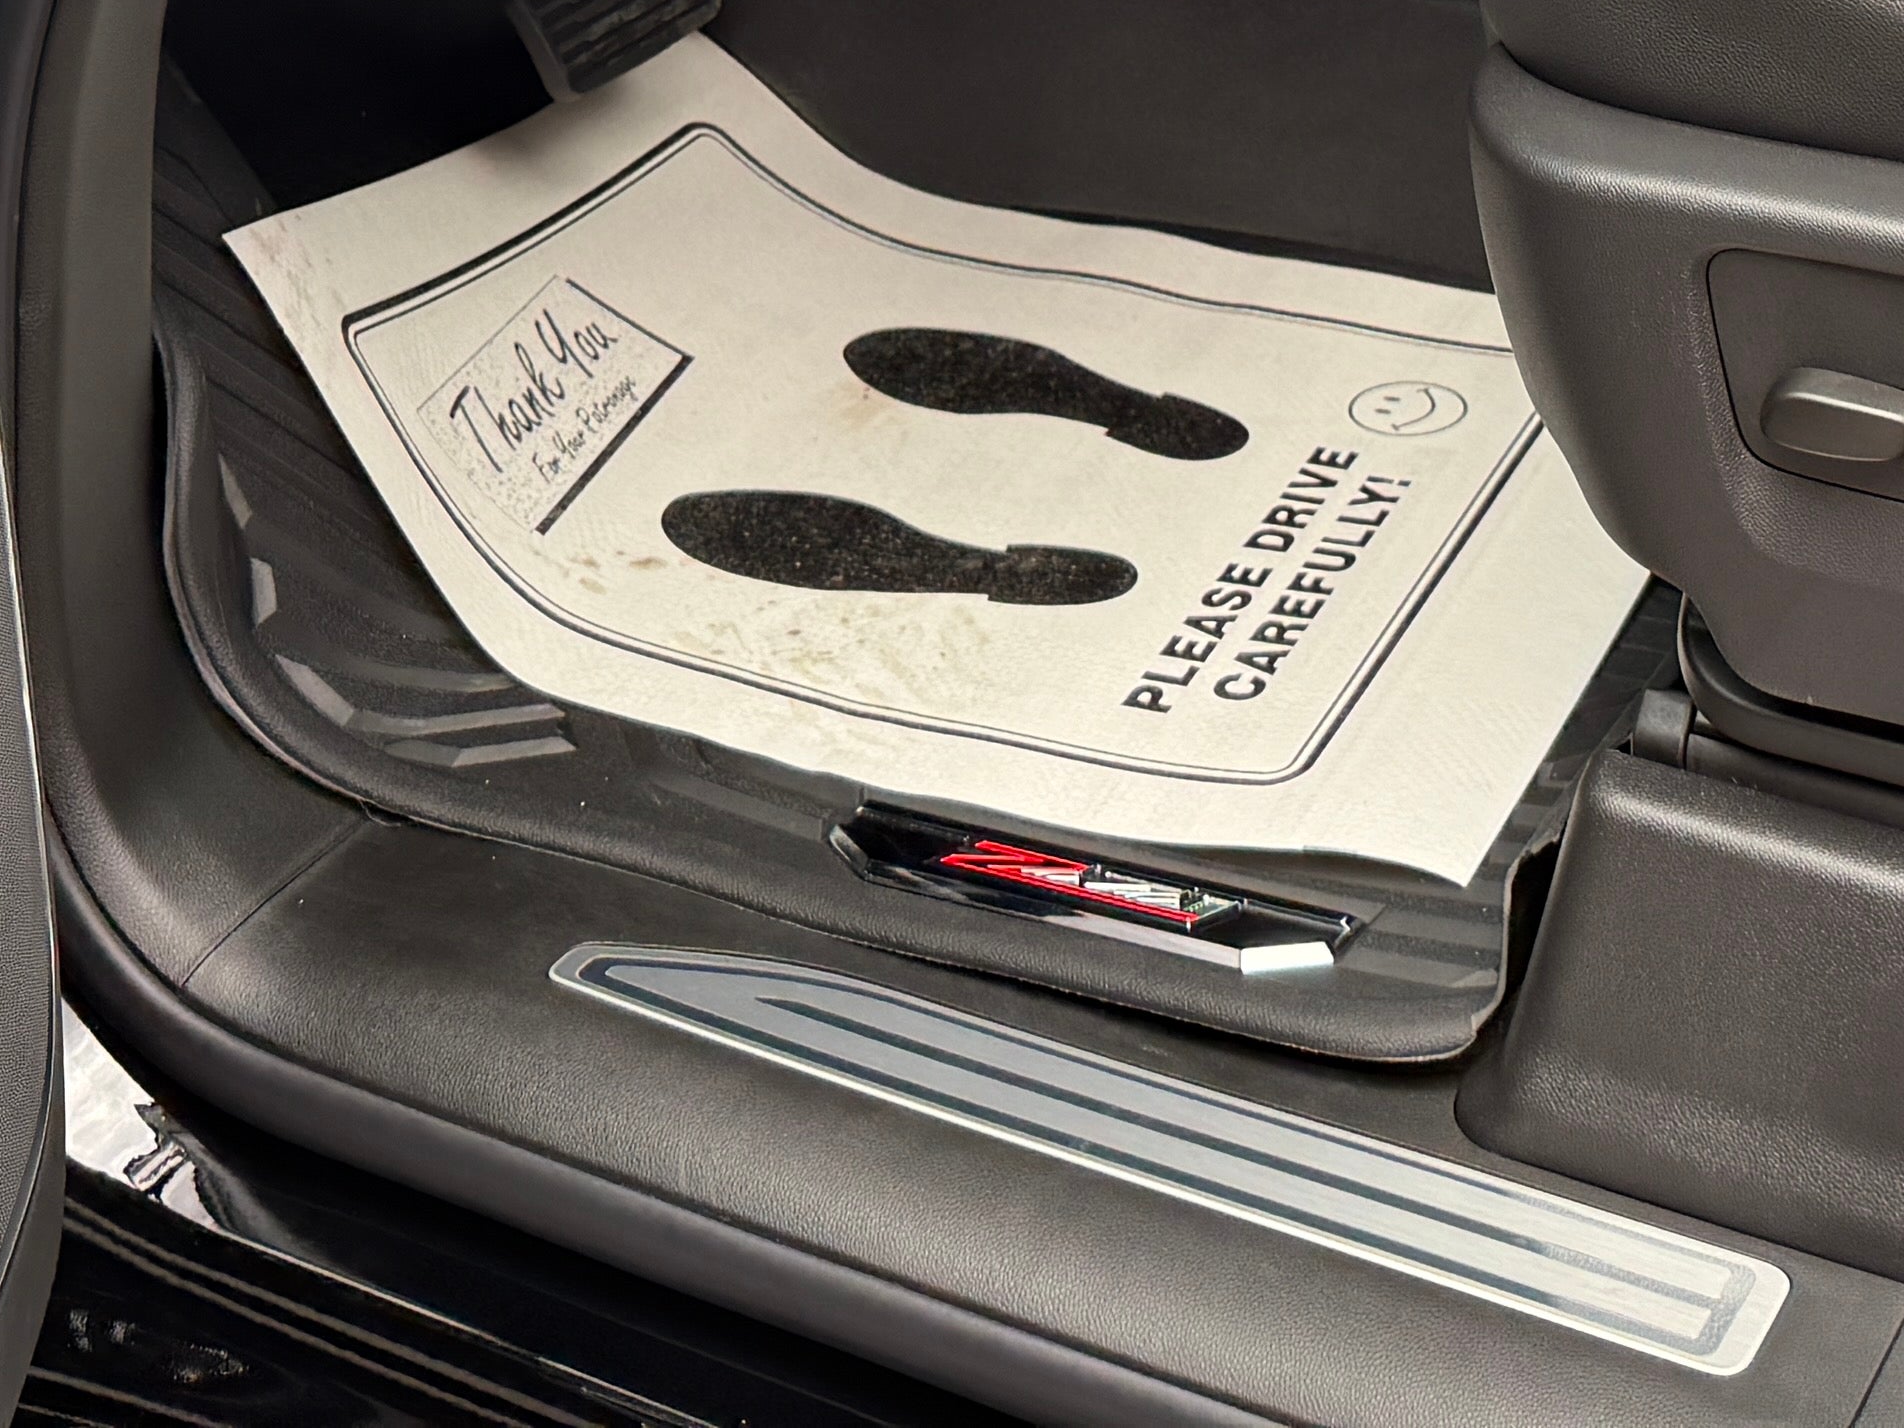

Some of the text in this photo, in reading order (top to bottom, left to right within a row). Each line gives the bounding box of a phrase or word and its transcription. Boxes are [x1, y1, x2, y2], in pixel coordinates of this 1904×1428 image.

[450, 308, 619, 473] Thank You
[532, 451, 561, 484] For
[1120, 446, 1360, 714] PLEASE DRIVE
[1213, 475, 1412, 701] CAREFULLY!
